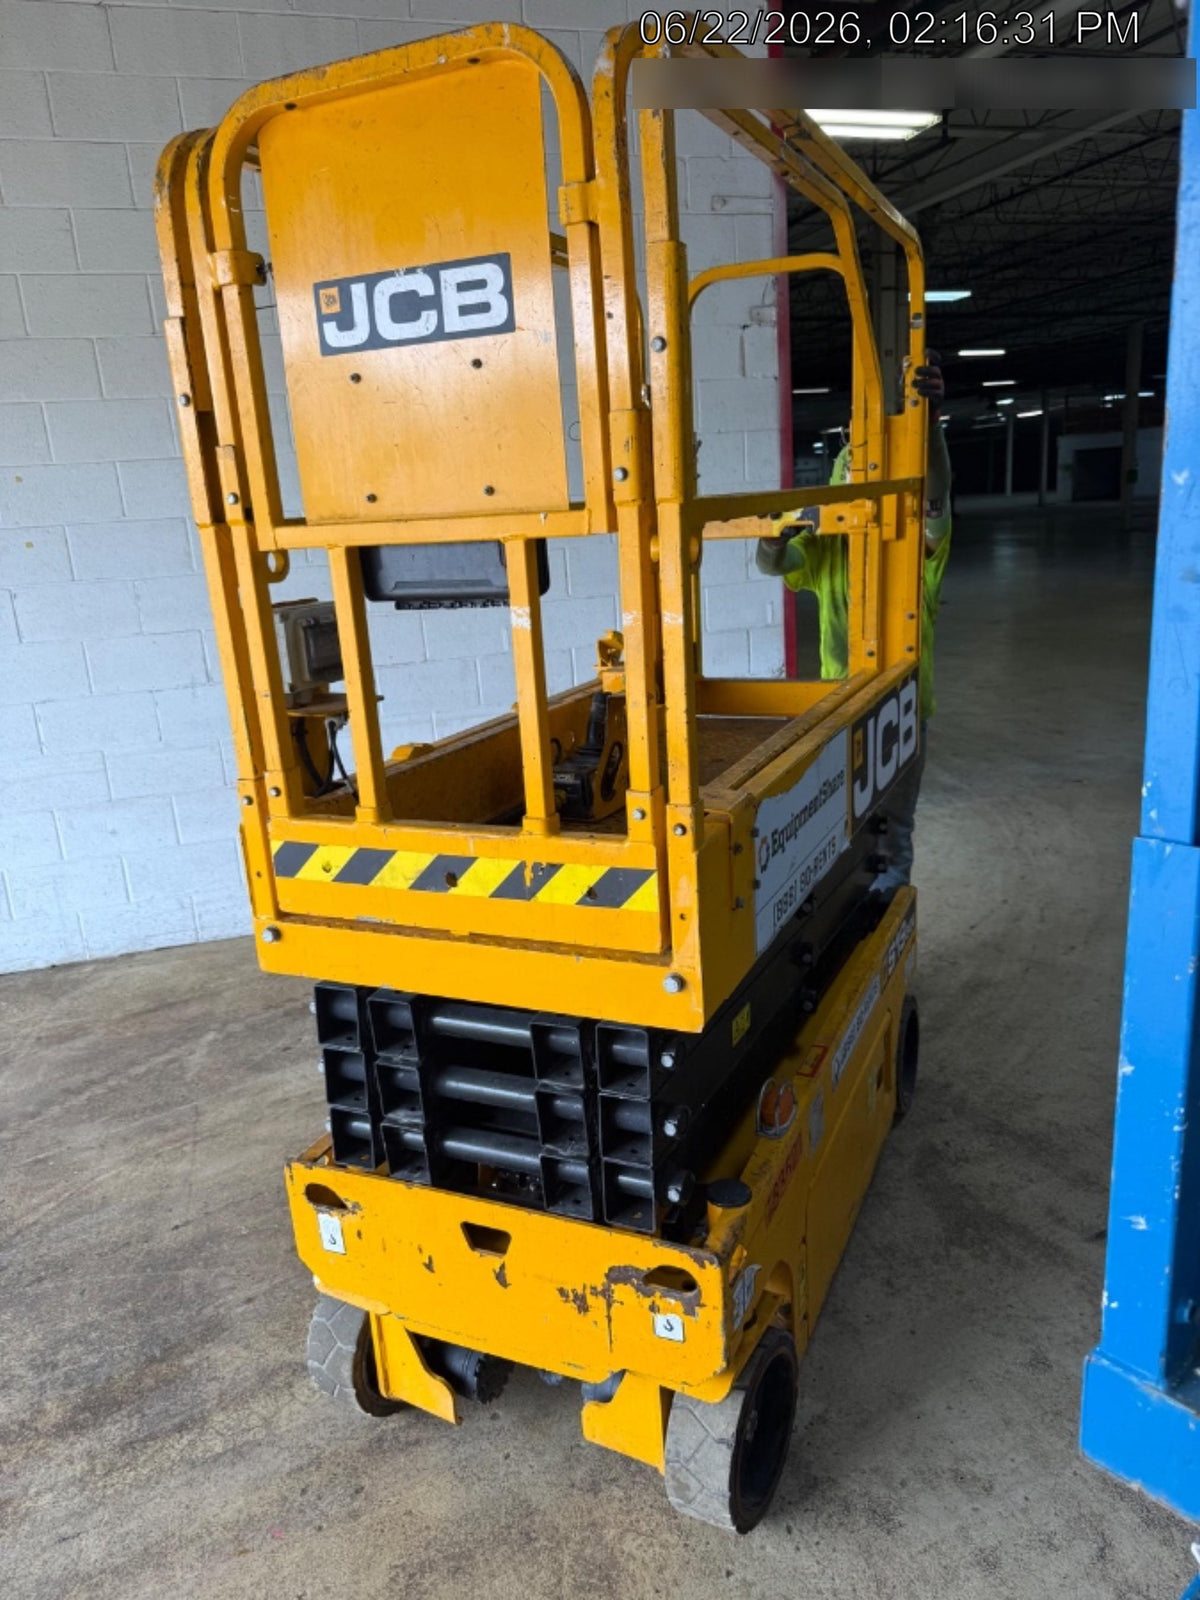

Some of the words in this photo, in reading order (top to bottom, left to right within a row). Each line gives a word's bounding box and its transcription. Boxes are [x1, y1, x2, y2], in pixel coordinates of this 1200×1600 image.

[322, 262, 509, 348] JCB
[853, 680, 917, 818] JCB
[771, 769, 845, 857] EquipmentShare
